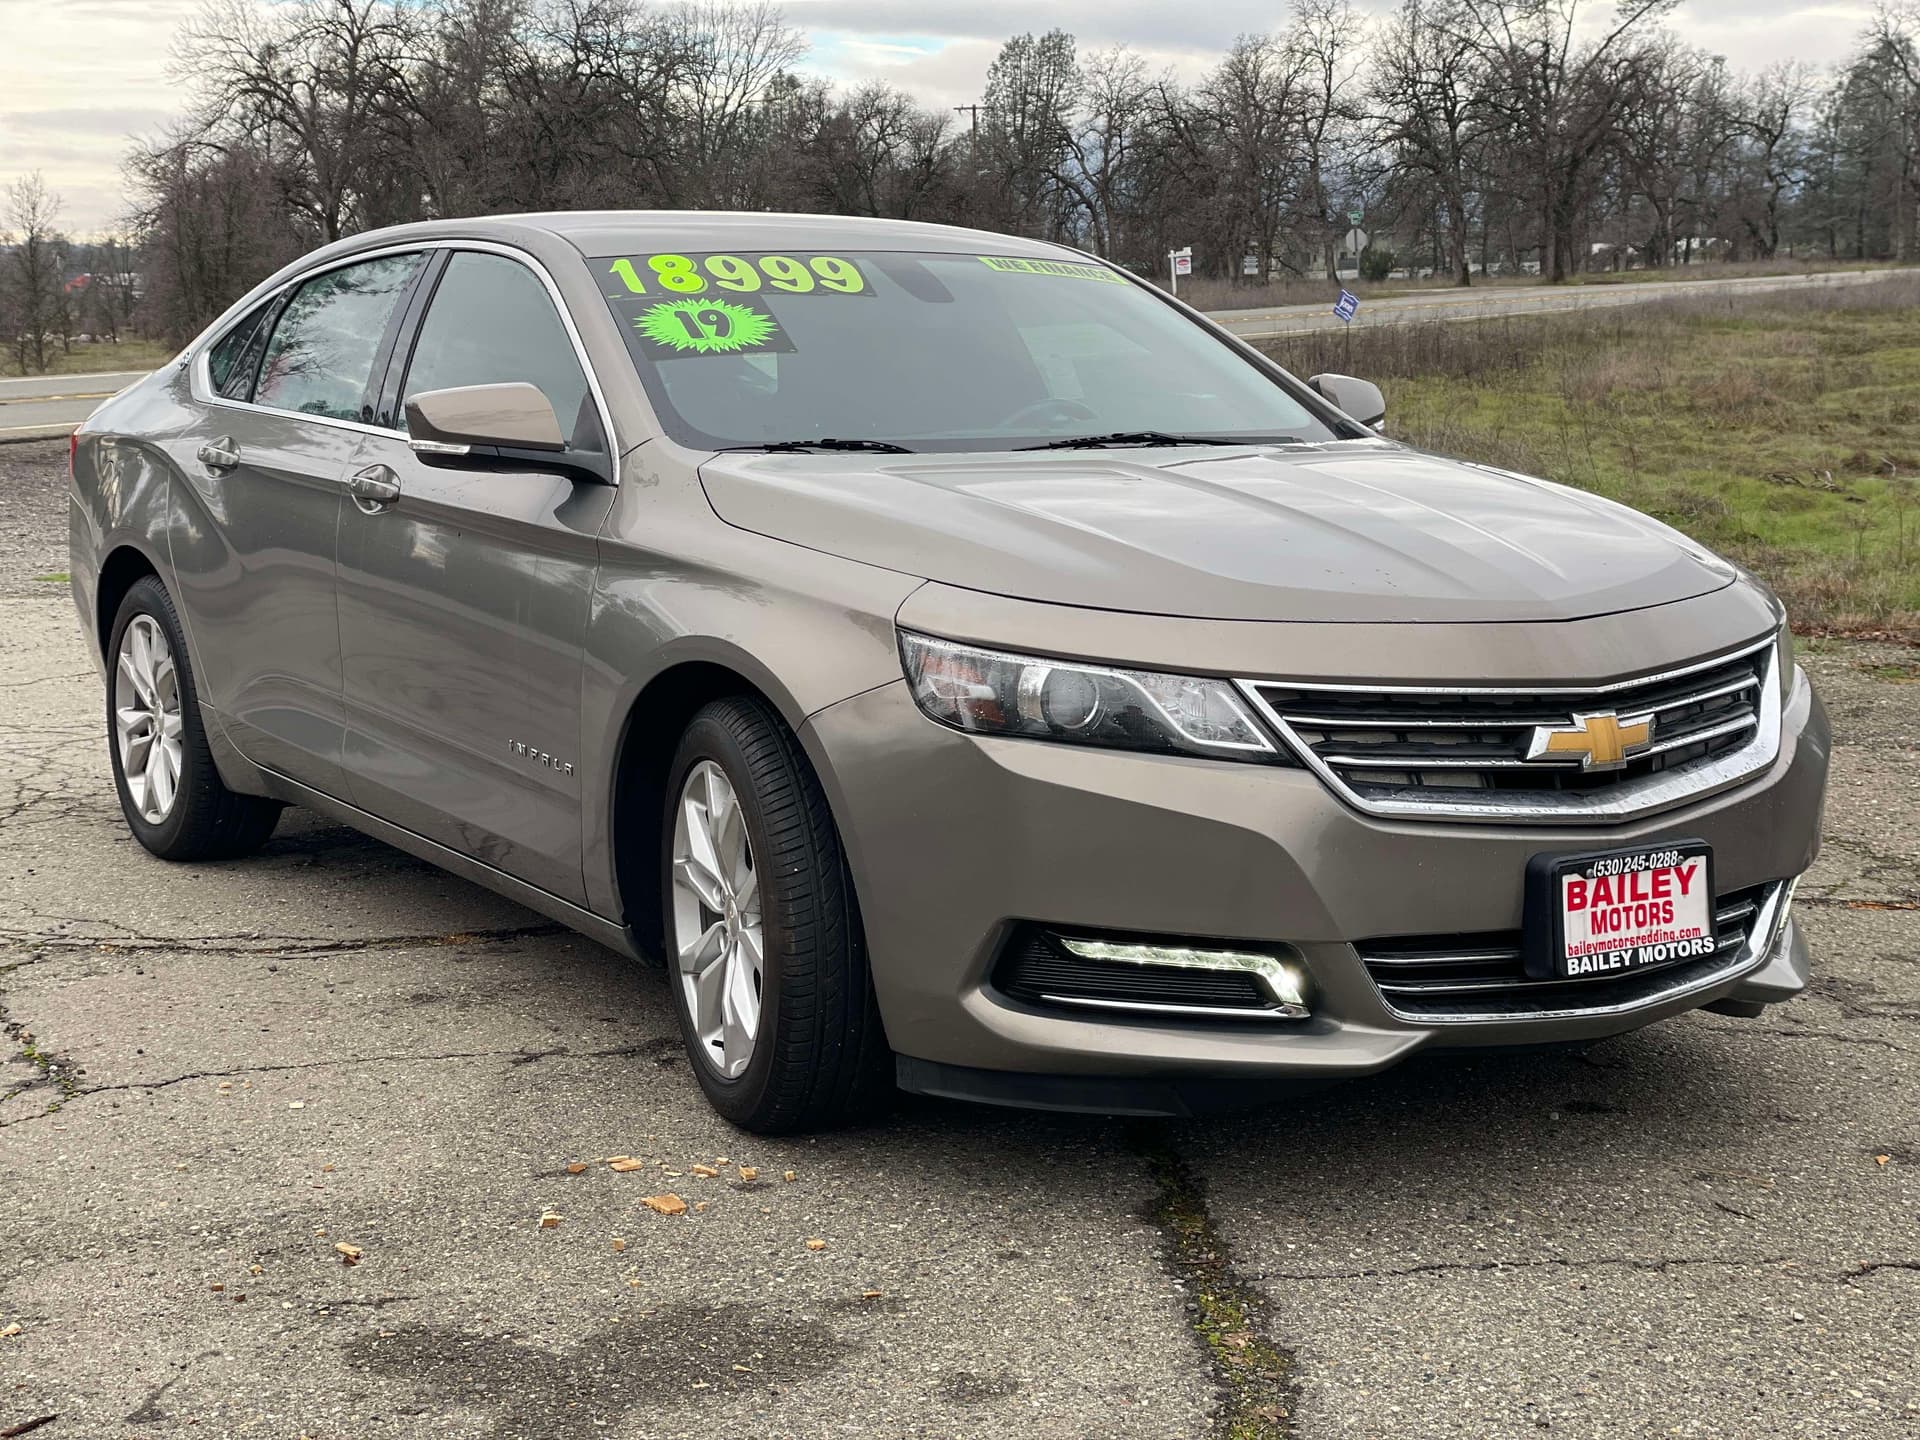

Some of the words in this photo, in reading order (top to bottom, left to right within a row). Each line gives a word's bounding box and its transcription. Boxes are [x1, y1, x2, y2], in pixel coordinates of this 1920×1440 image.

[609, 254, 864, 294] 18999
[989, 258, 1025, 271] WE
[1028, 262, 1113, 281] FINANCE
[674, 309, 736, 340] 19
[508, 739, 574, 776] IMPALA
[1567, 865, 1697, 912] BAILEY
[1591, 900, 1674, 935] MOTORS
[1567, 950, 1633, 976] BAILEY
[1638, 937, 1715, 964] MOTORS
[1568, 928, 1701, 957] baileymotorsredding.com
